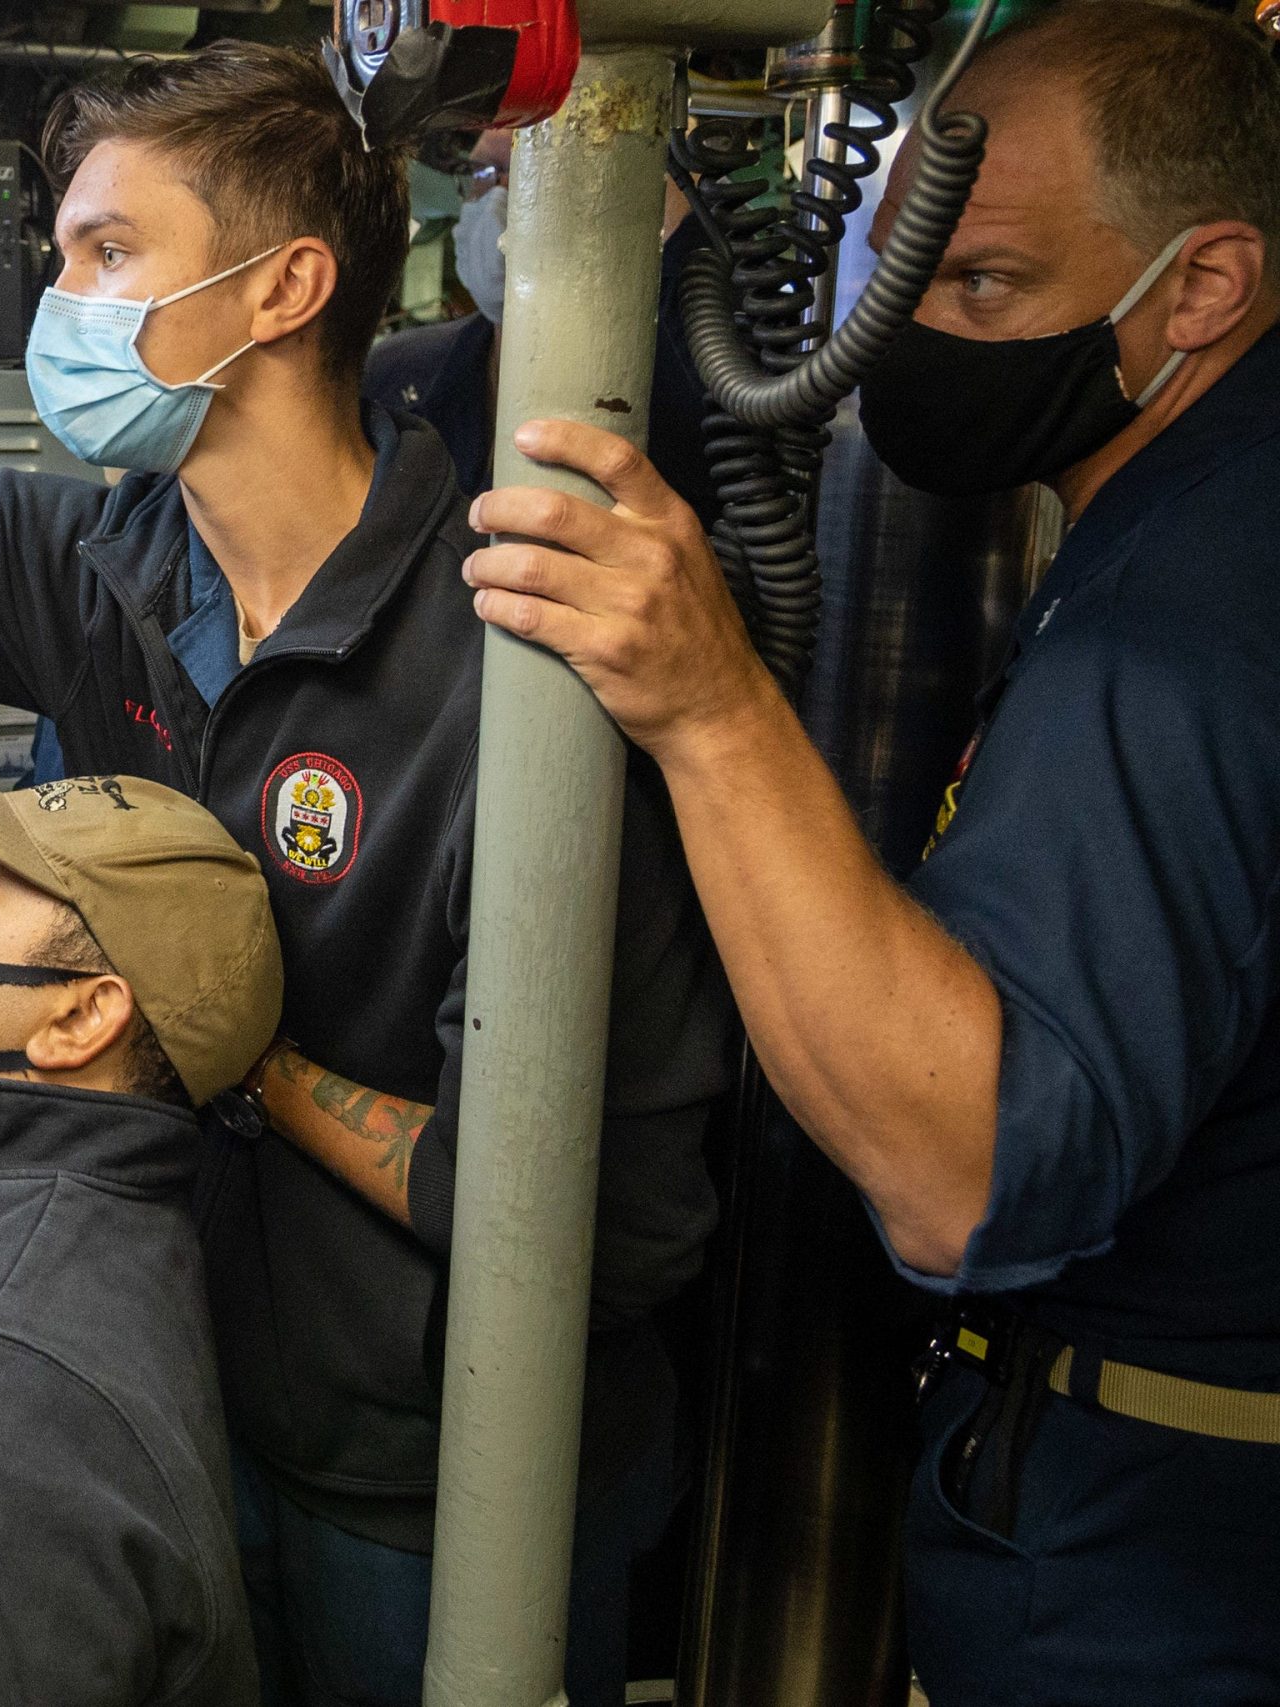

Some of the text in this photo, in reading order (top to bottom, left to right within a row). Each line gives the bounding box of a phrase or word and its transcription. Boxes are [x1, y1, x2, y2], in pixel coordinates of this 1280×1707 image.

[280, 758, 353, 792] USS CHICAGO
[288, 849, 327, 868] WE WILL
